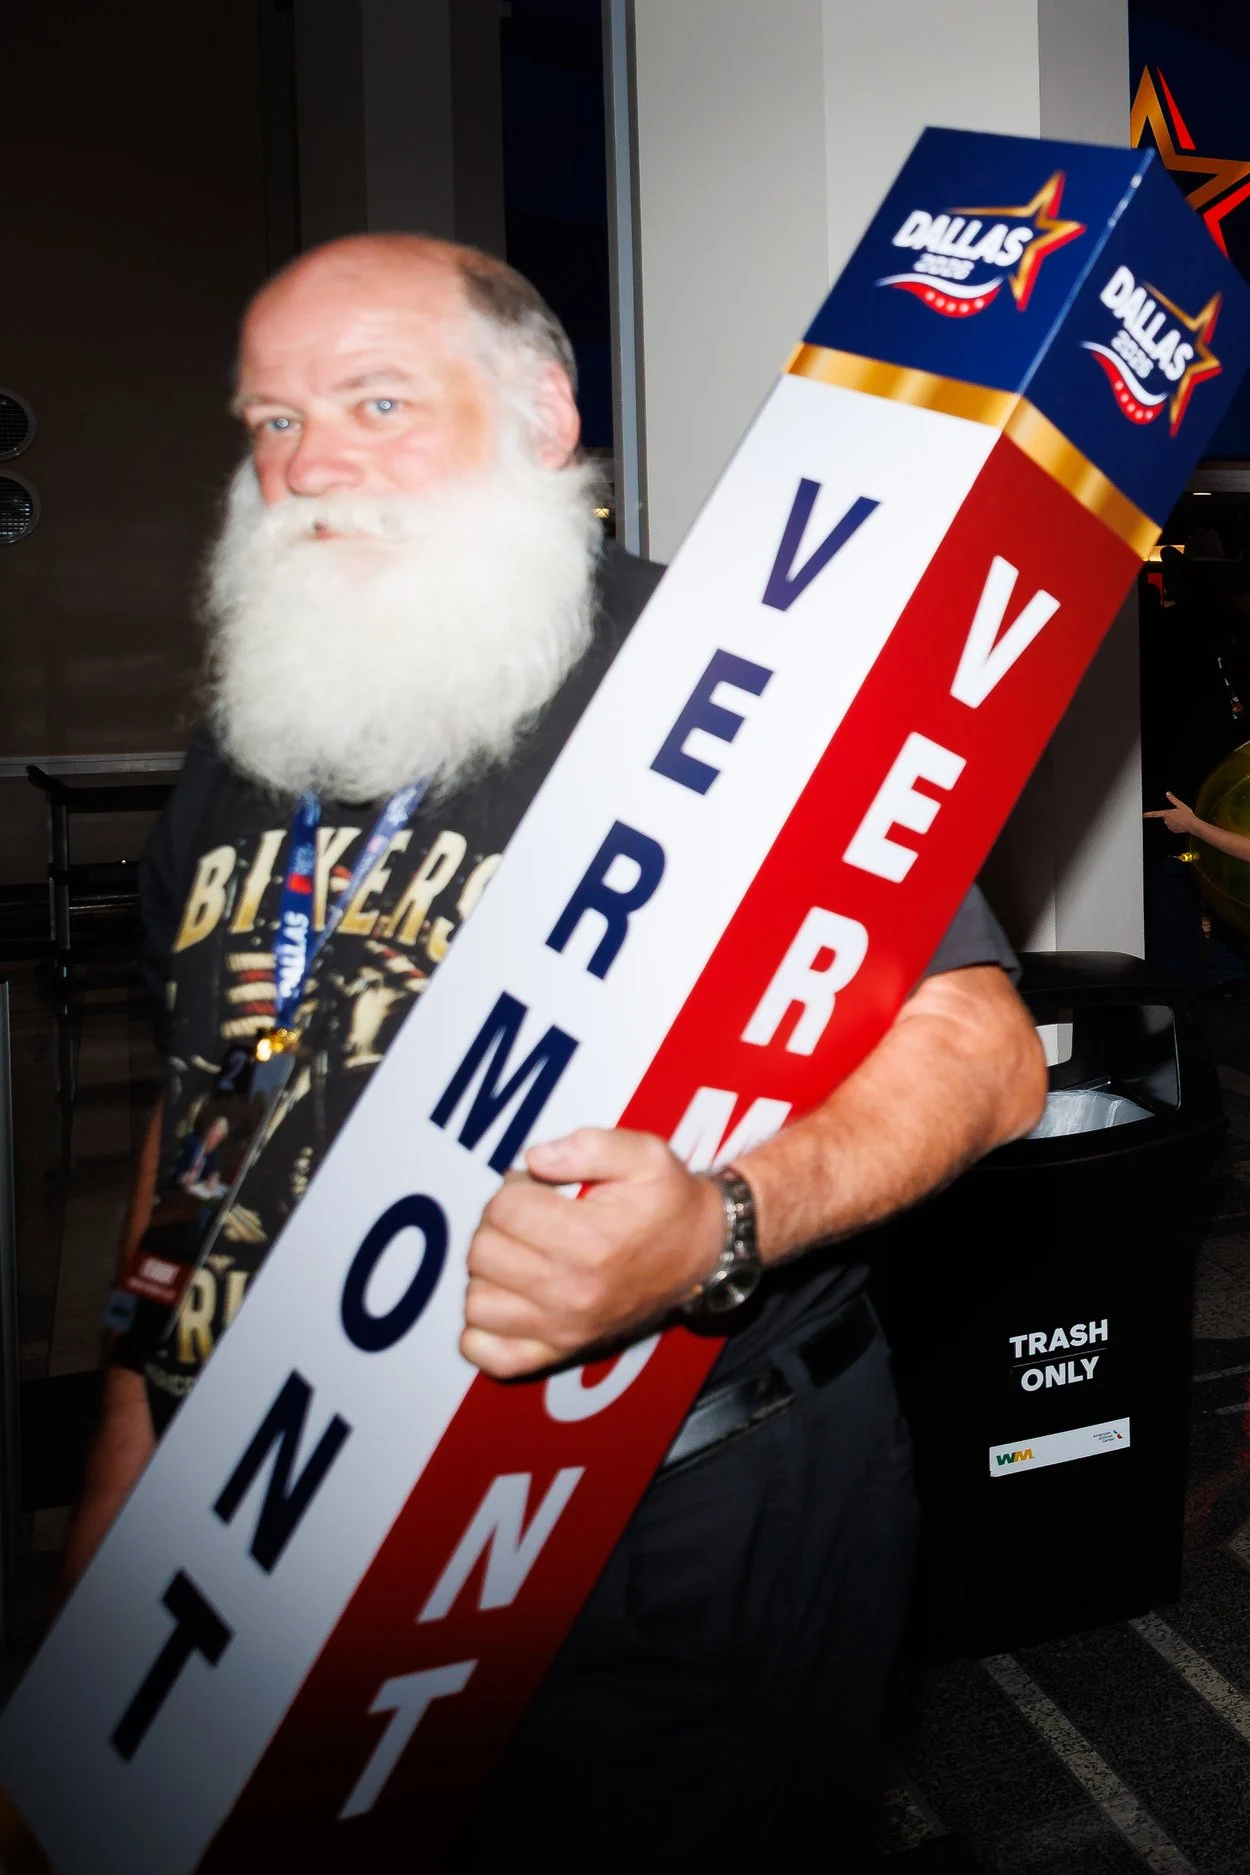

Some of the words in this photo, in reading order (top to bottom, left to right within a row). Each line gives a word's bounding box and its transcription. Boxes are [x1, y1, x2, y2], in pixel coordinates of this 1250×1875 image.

[891, 209, 1034, 267] DALLAS
[912, 252, 975, 281] 2026
[1100, 264, 1194, 382] DALLAS
[1110, 329, 1156, 379] 2026
[108, 477, 882, 1765] VERMONT
[1009, 1318, 1109, 1359] TRASH
[1021, 1355, 1100, 1392] ONLY
[996, 1448, 1034, 1466] WM
